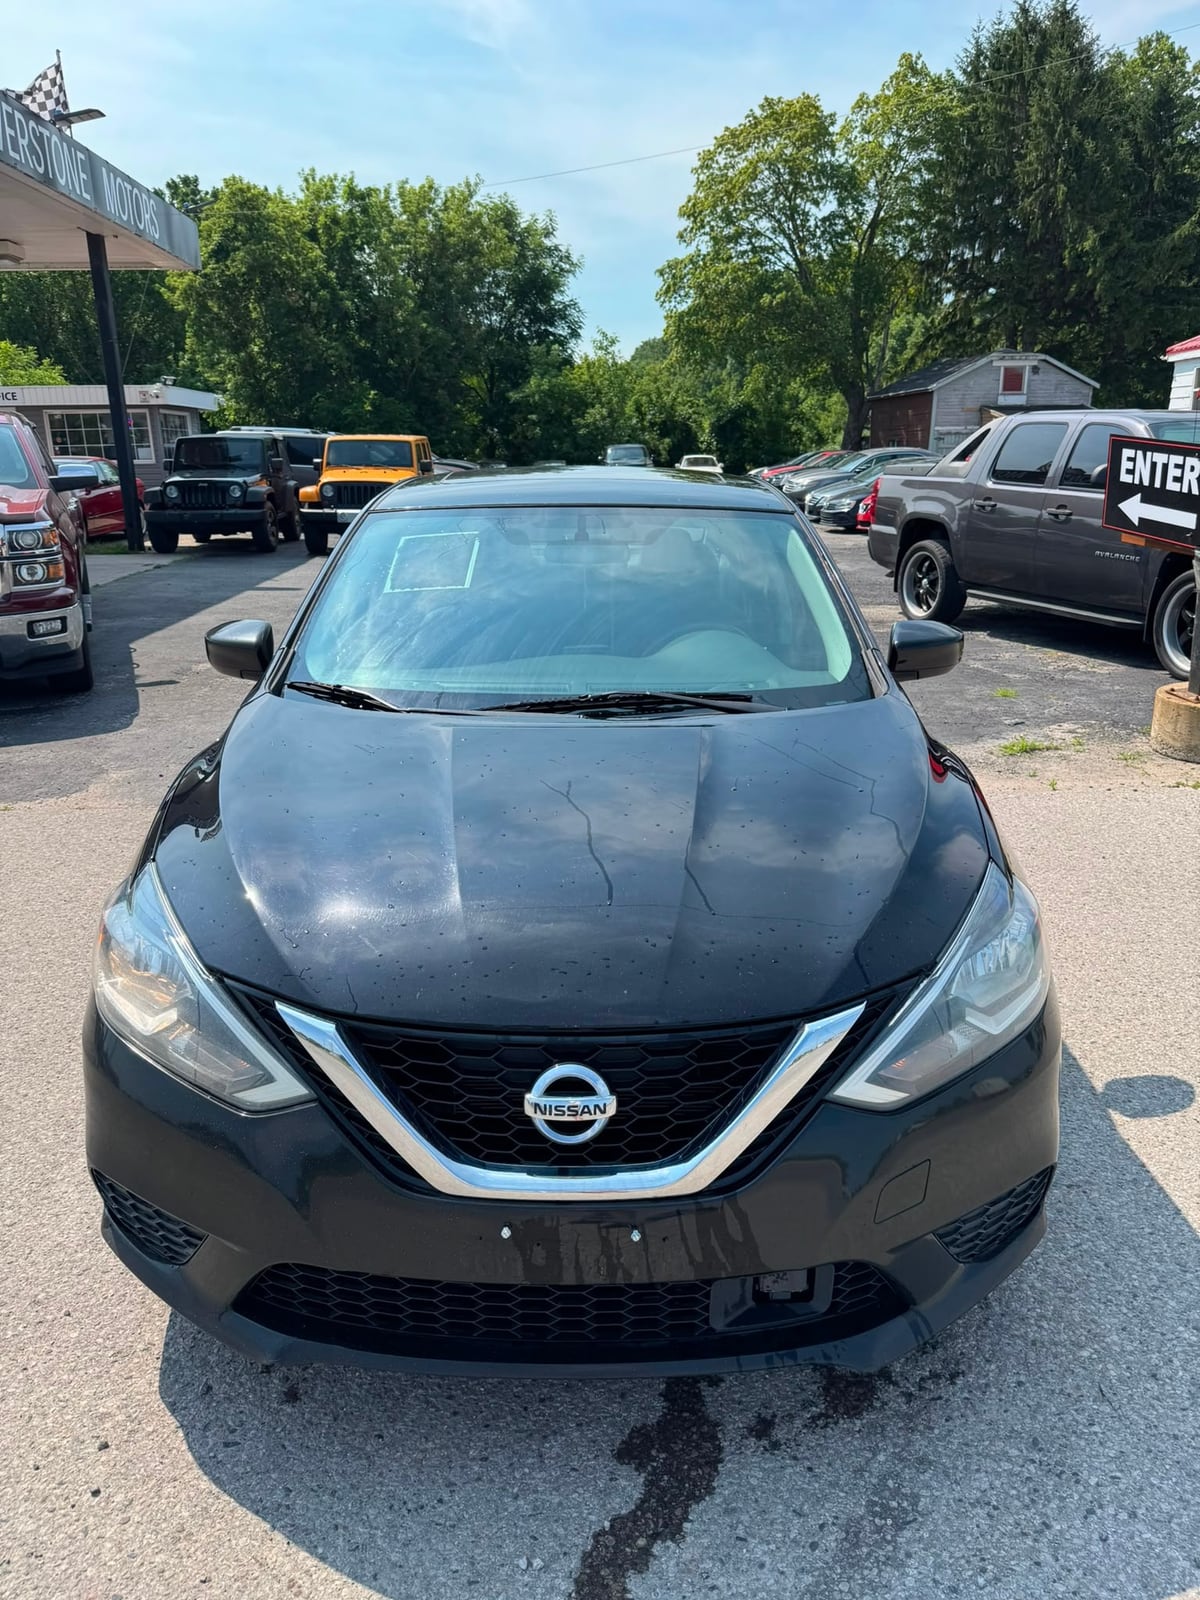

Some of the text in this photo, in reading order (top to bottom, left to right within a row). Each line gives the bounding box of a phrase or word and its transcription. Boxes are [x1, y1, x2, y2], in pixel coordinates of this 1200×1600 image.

[0, 101, 160, 240] ERSTONE MOTORS
[0, 391, 18, 401] ICE
[1120, 447, 1200, 496] ENTER
[1094, 550, 1141, 562] AVALANCHE
[533, 1102, 607, 1117] NISSAN
